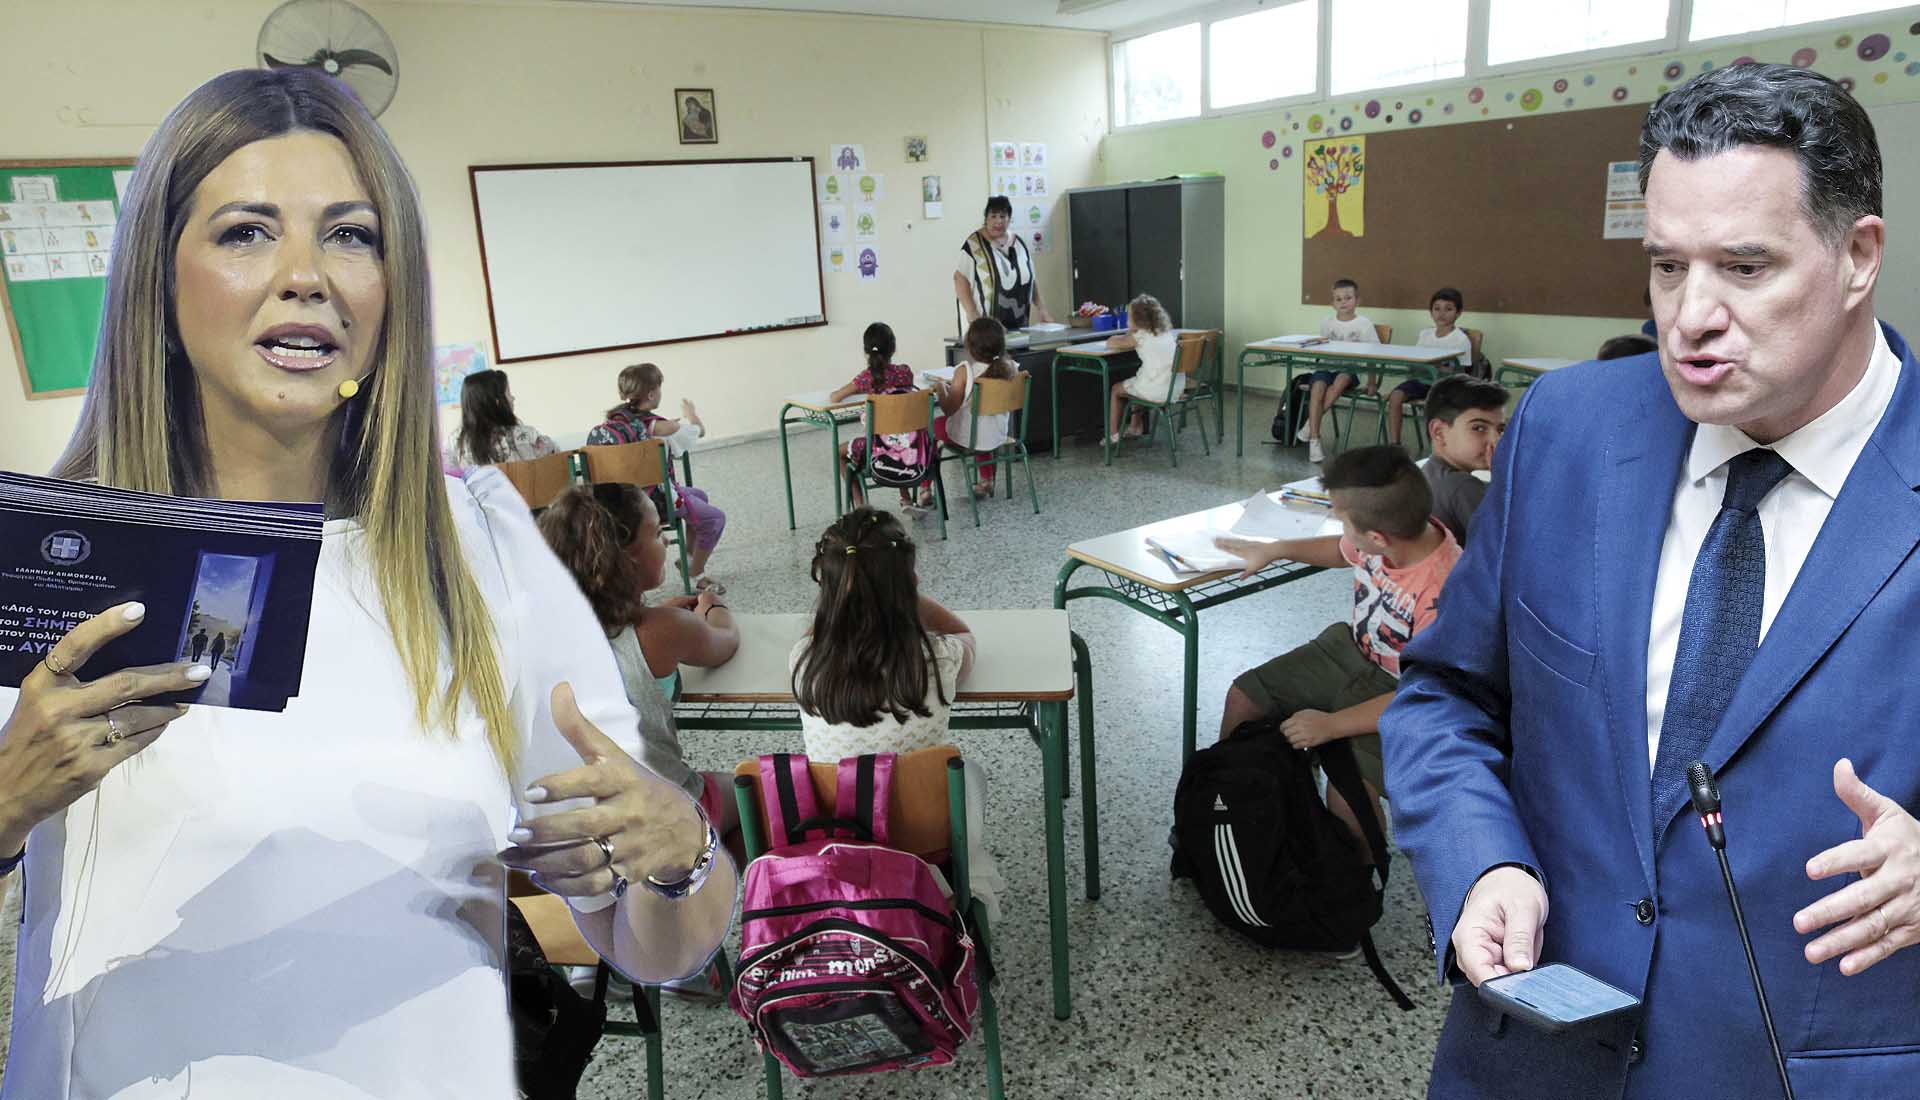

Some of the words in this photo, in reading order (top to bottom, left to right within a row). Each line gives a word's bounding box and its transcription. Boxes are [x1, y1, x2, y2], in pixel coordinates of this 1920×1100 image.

[15, 567, 54, 576] ΕΛΛΗΝΙΚΗ
[56, 571, 107, 582] ΔΗΜΟΚΡΑΤΙΑ
[1, 603, 34, 614] «Από
[37, 608, 59, 617] τον
